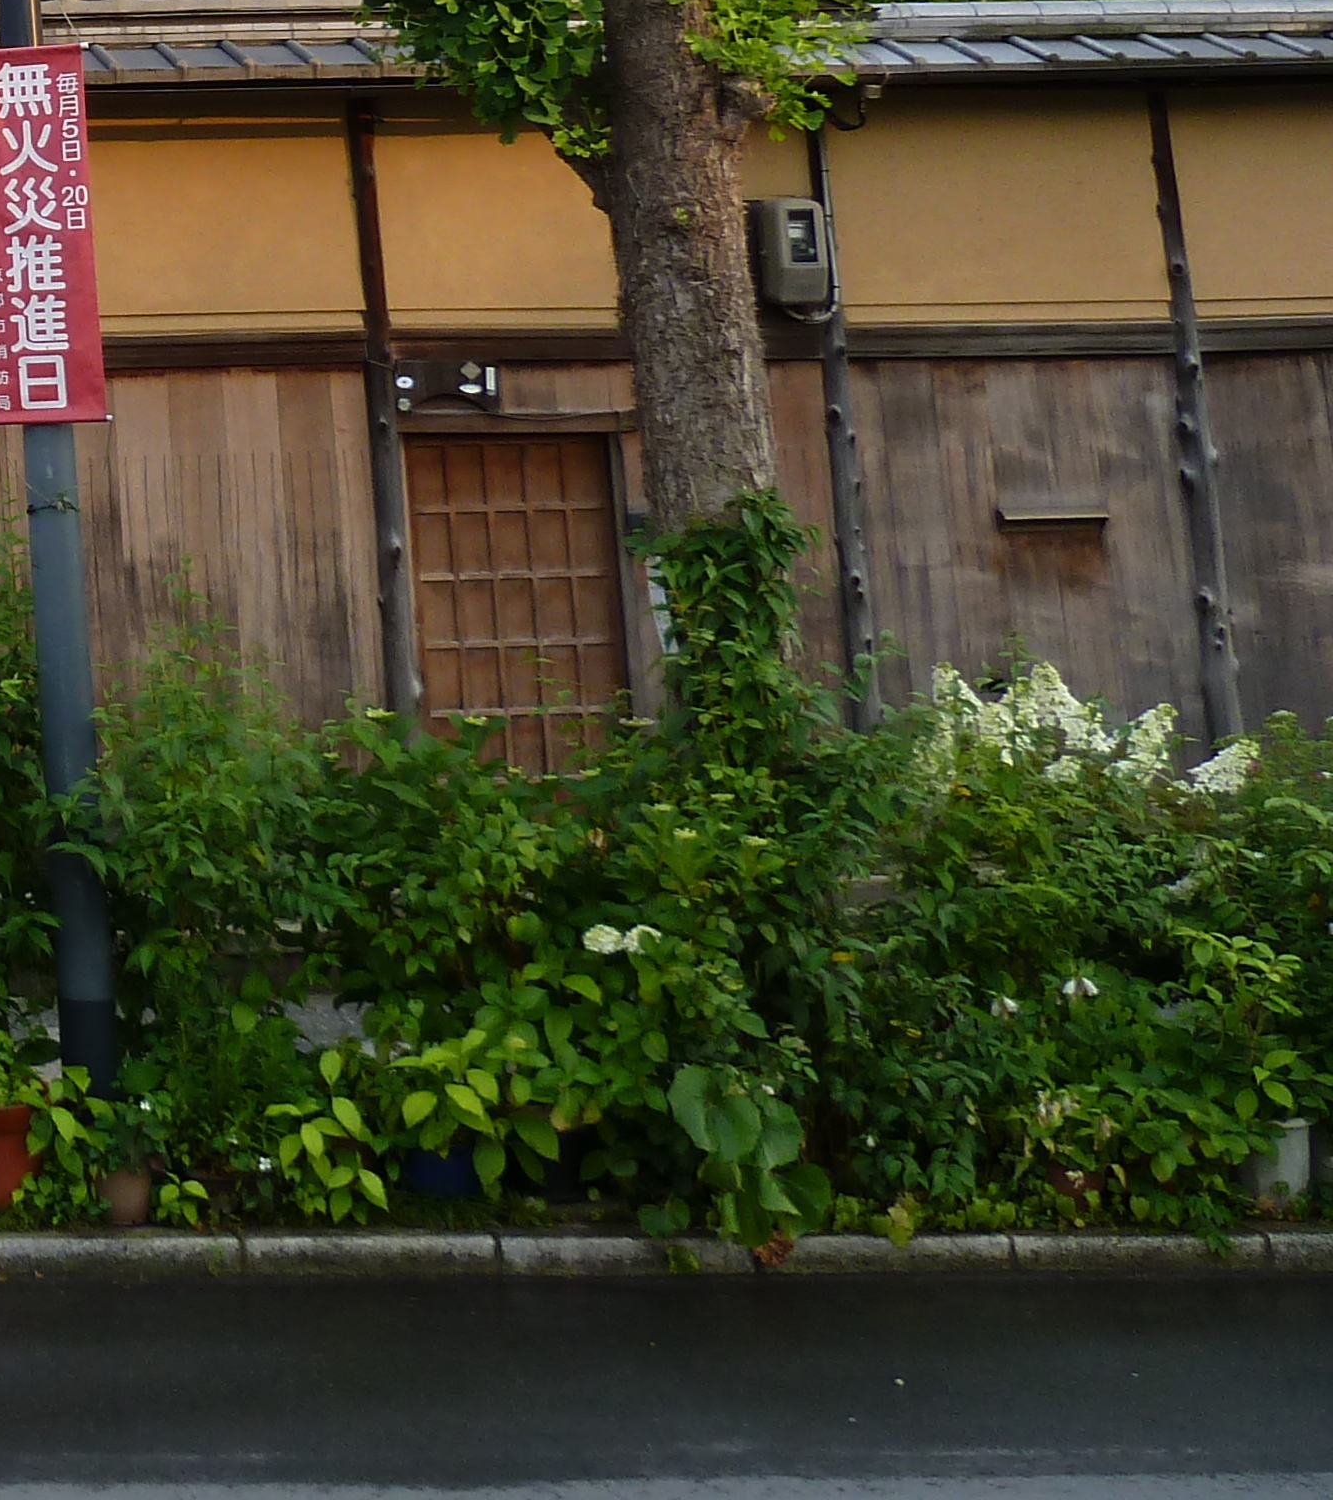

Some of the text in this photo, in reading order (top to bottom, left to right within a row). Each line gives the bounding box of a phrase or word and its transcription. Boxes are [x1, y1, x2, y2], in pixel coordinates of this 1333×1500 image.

[56, 72, 89, 230] 毎月5日・20日
